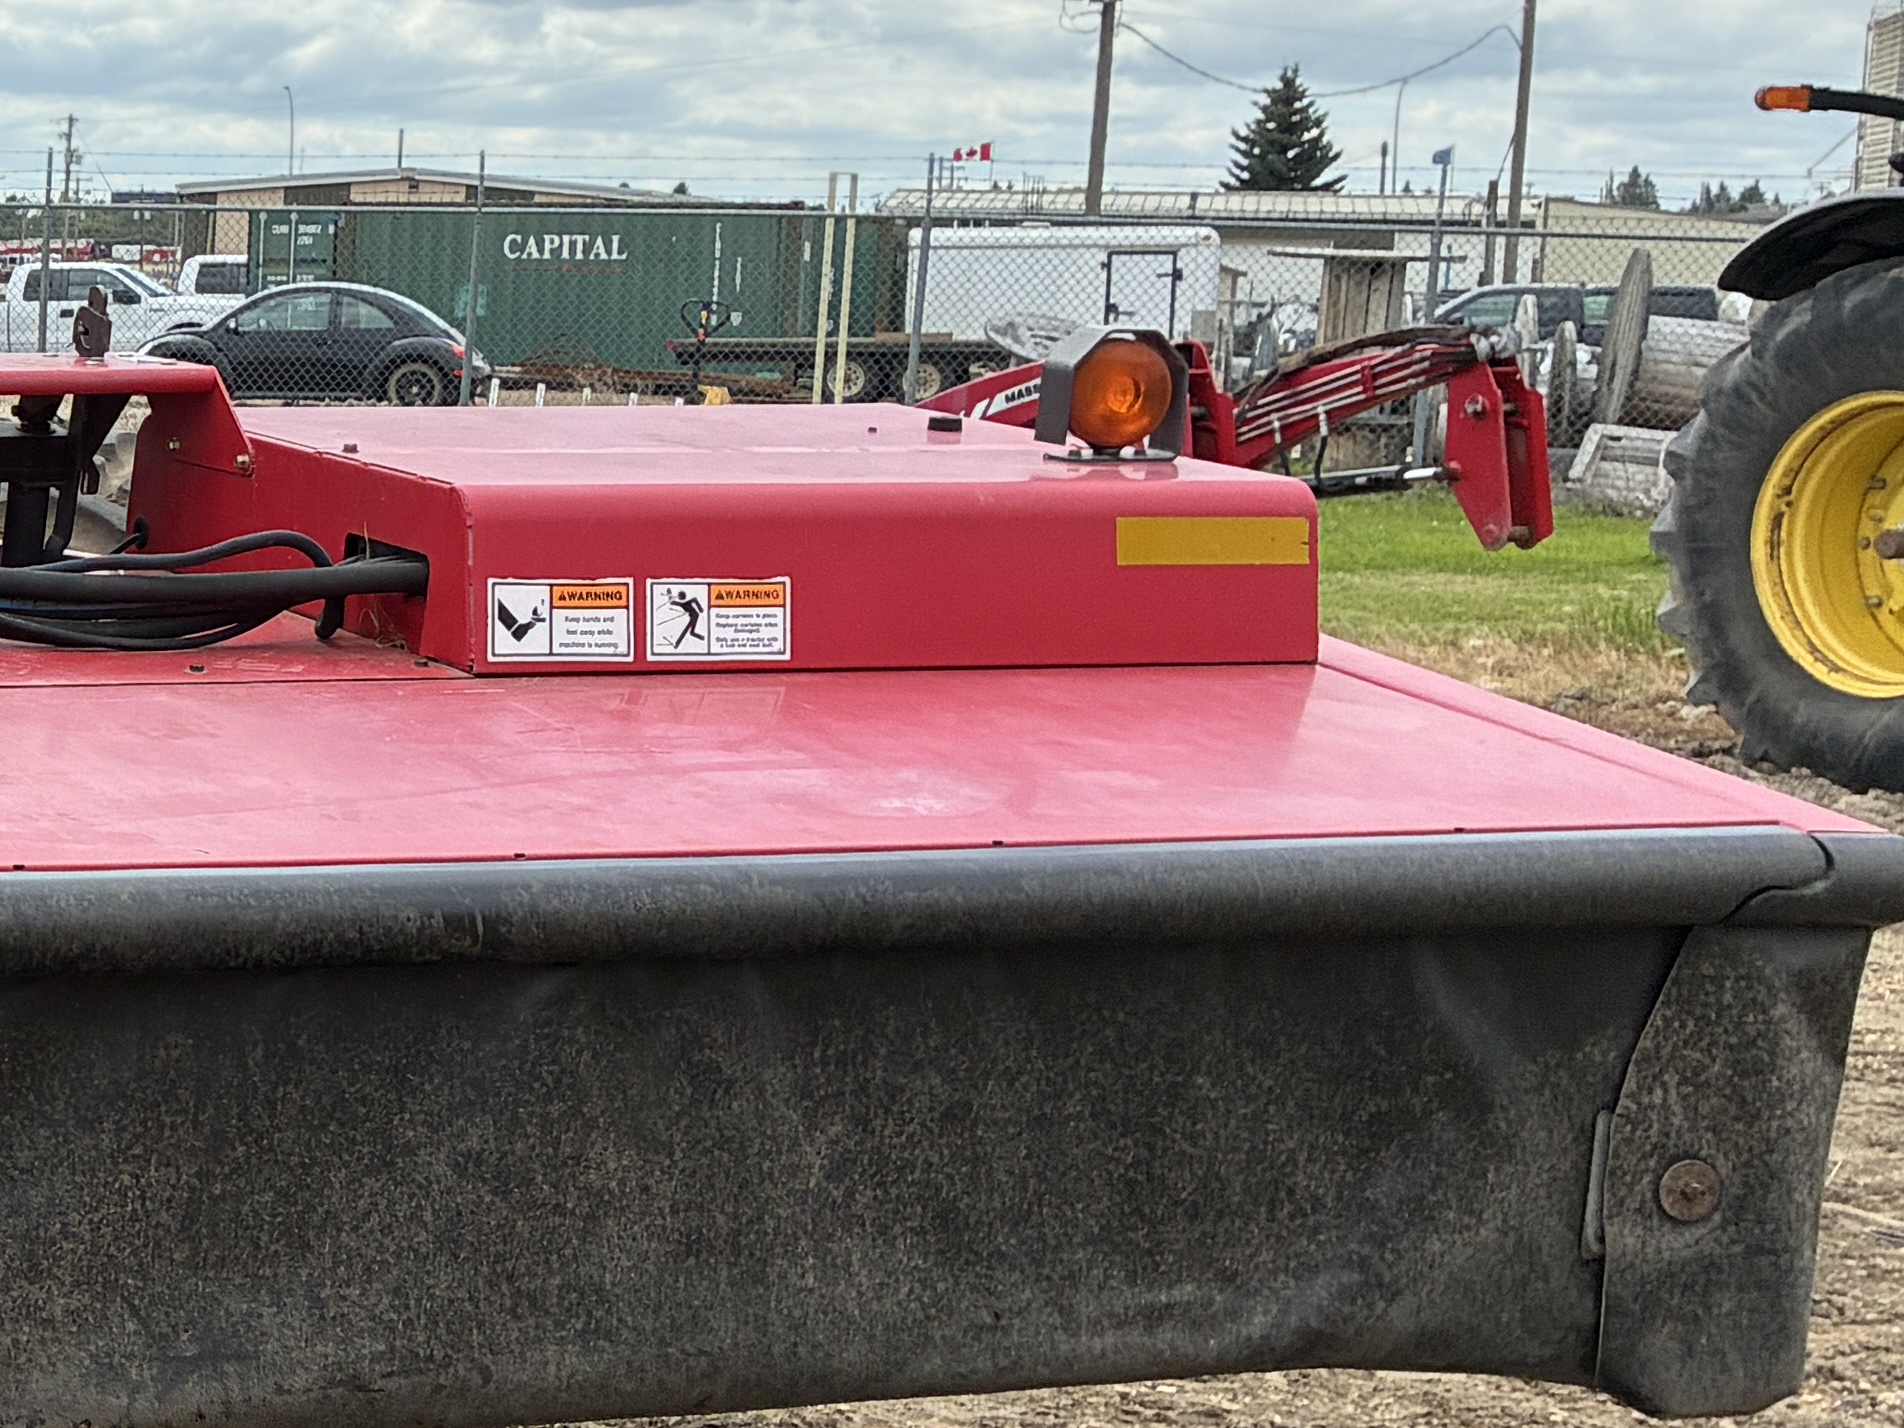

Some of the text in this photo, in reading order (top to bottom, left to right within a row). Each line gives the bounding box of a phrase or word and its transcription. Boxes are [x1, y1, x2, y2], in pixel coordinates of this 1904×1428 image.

[503, 234, 628, 260] CAPITAL
[567, 591, 622, 601] WARNING
[725, 589, 779, 600] WARNING
